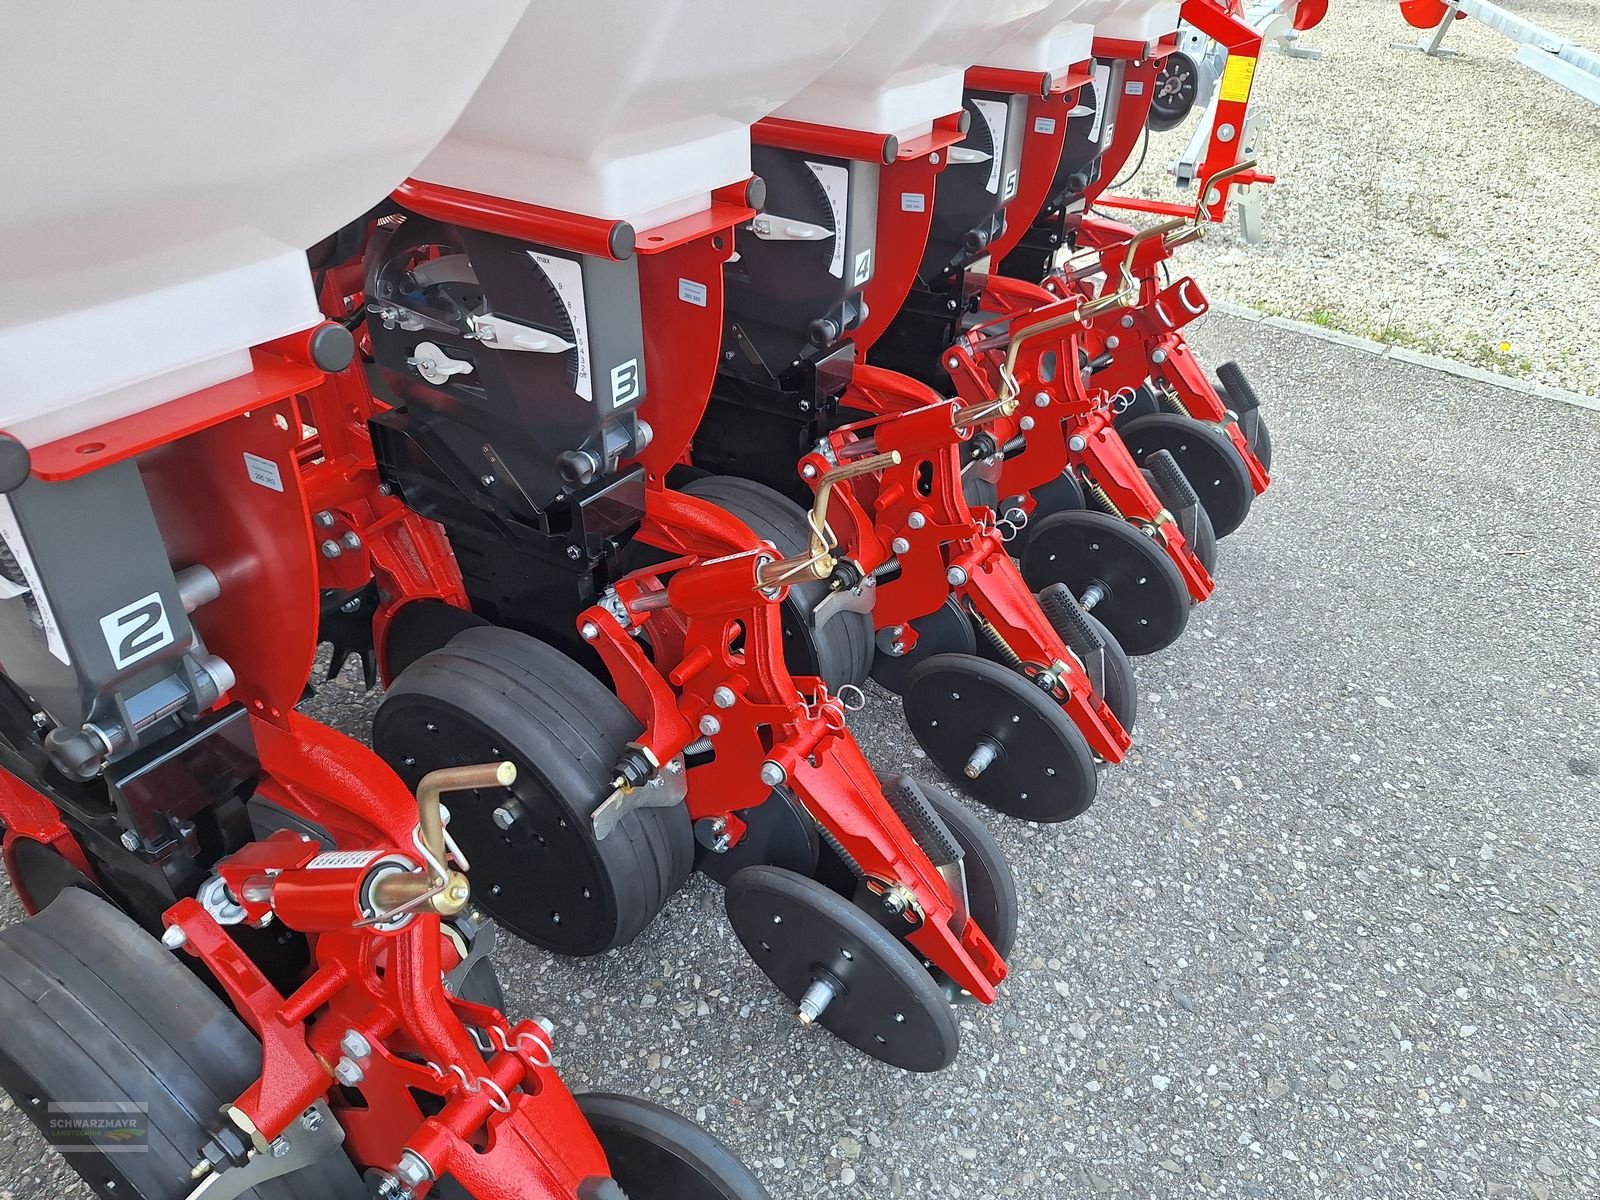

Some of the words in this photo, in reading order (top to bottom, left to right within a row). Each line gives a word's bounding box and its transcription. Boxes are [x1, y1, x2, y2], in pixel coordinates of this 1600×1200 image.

[1006, 174, 1016, 195] 5
[536, 255, 550, 264] max
[855, 254, 870, 279] 4
[558, 282, 563, 290] 9
[567, 301, 572, 309] 8
[576, 327, 581, 335] 6
[616, 364, 637, 403] 3
[117, 601, 164, 662] 2
